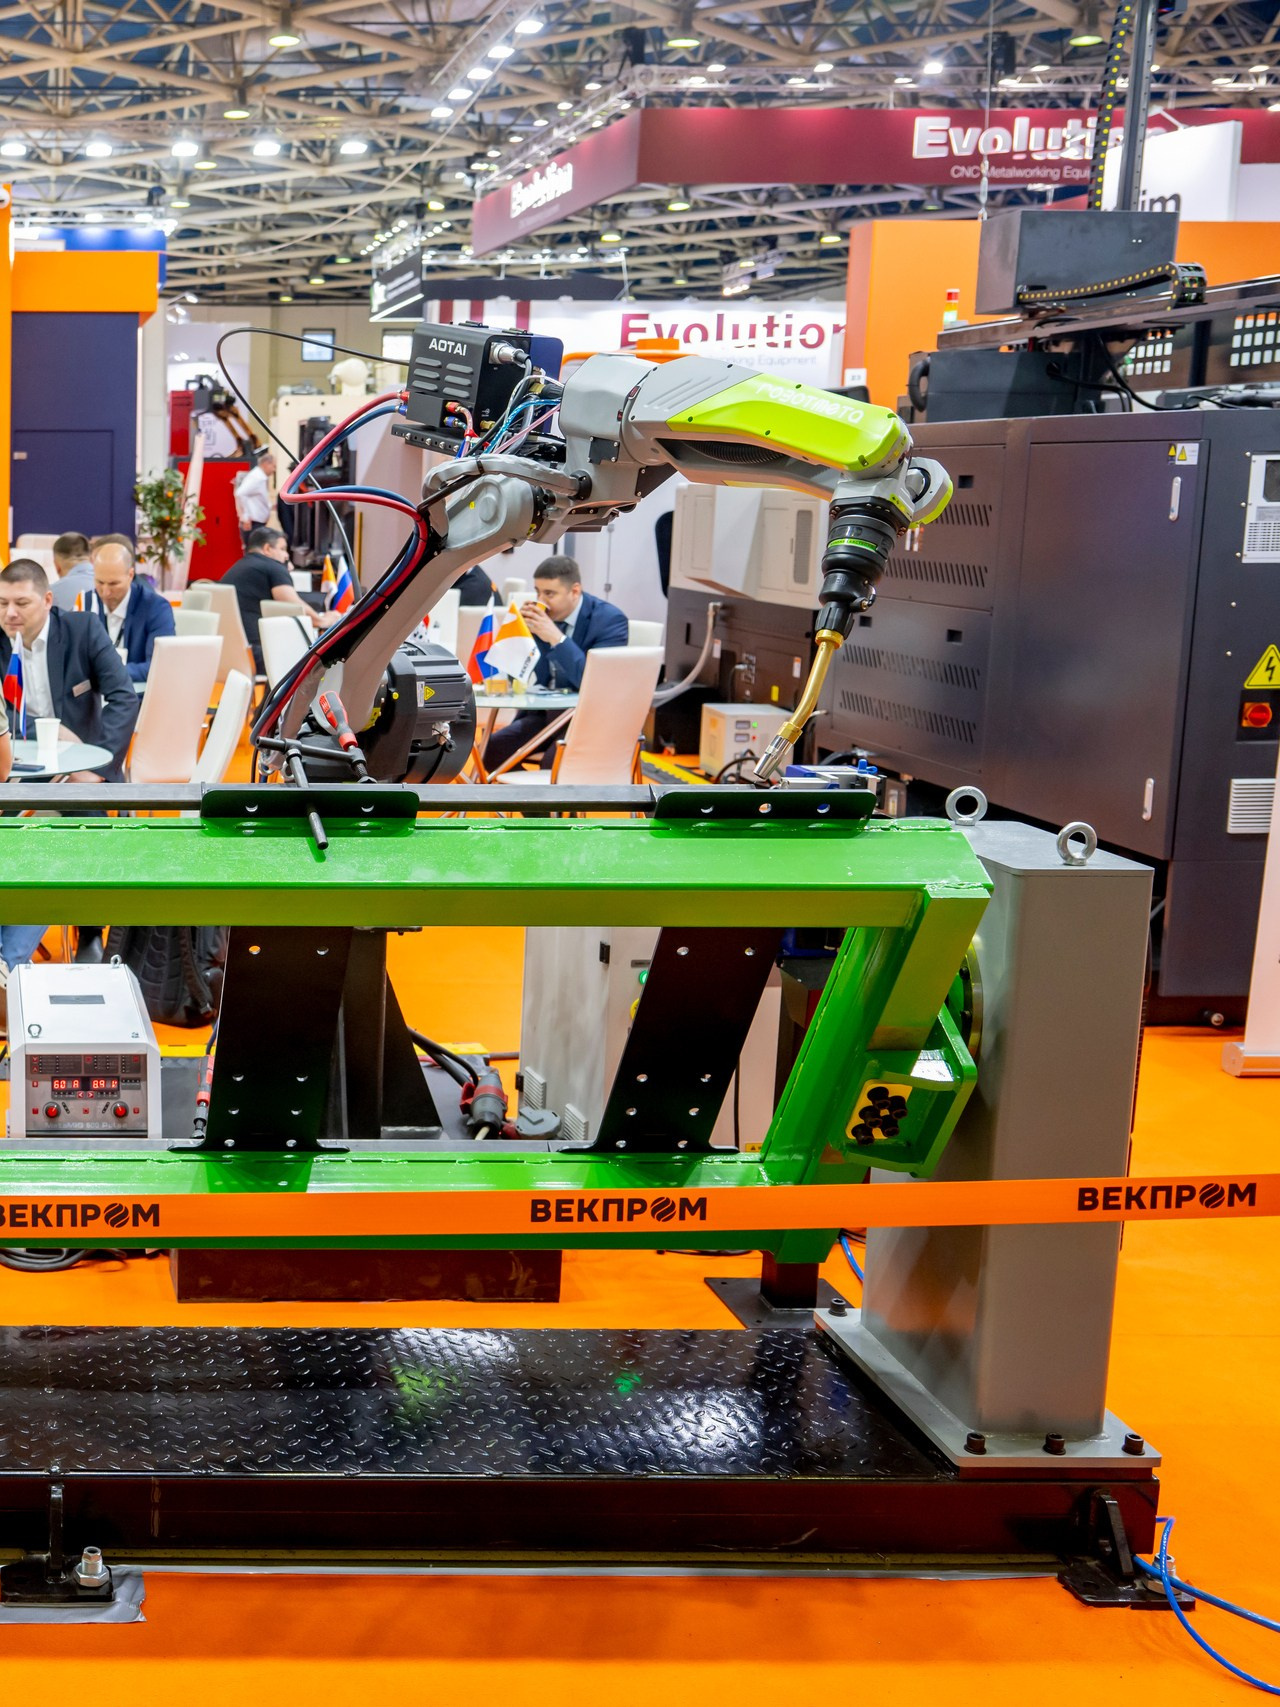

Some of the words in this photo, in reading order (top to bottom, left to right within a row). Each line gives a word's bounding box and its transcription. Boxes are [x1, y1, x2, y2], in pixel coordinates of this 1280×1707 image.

[429, 337, 467, 356] AOTAI
[53, 1079, 66, 1089] 60
[1077, 1182, 1256, 1210] ВЕКПРОМ
[530, 1197, 706, 1222] ВЕКПРОМ
